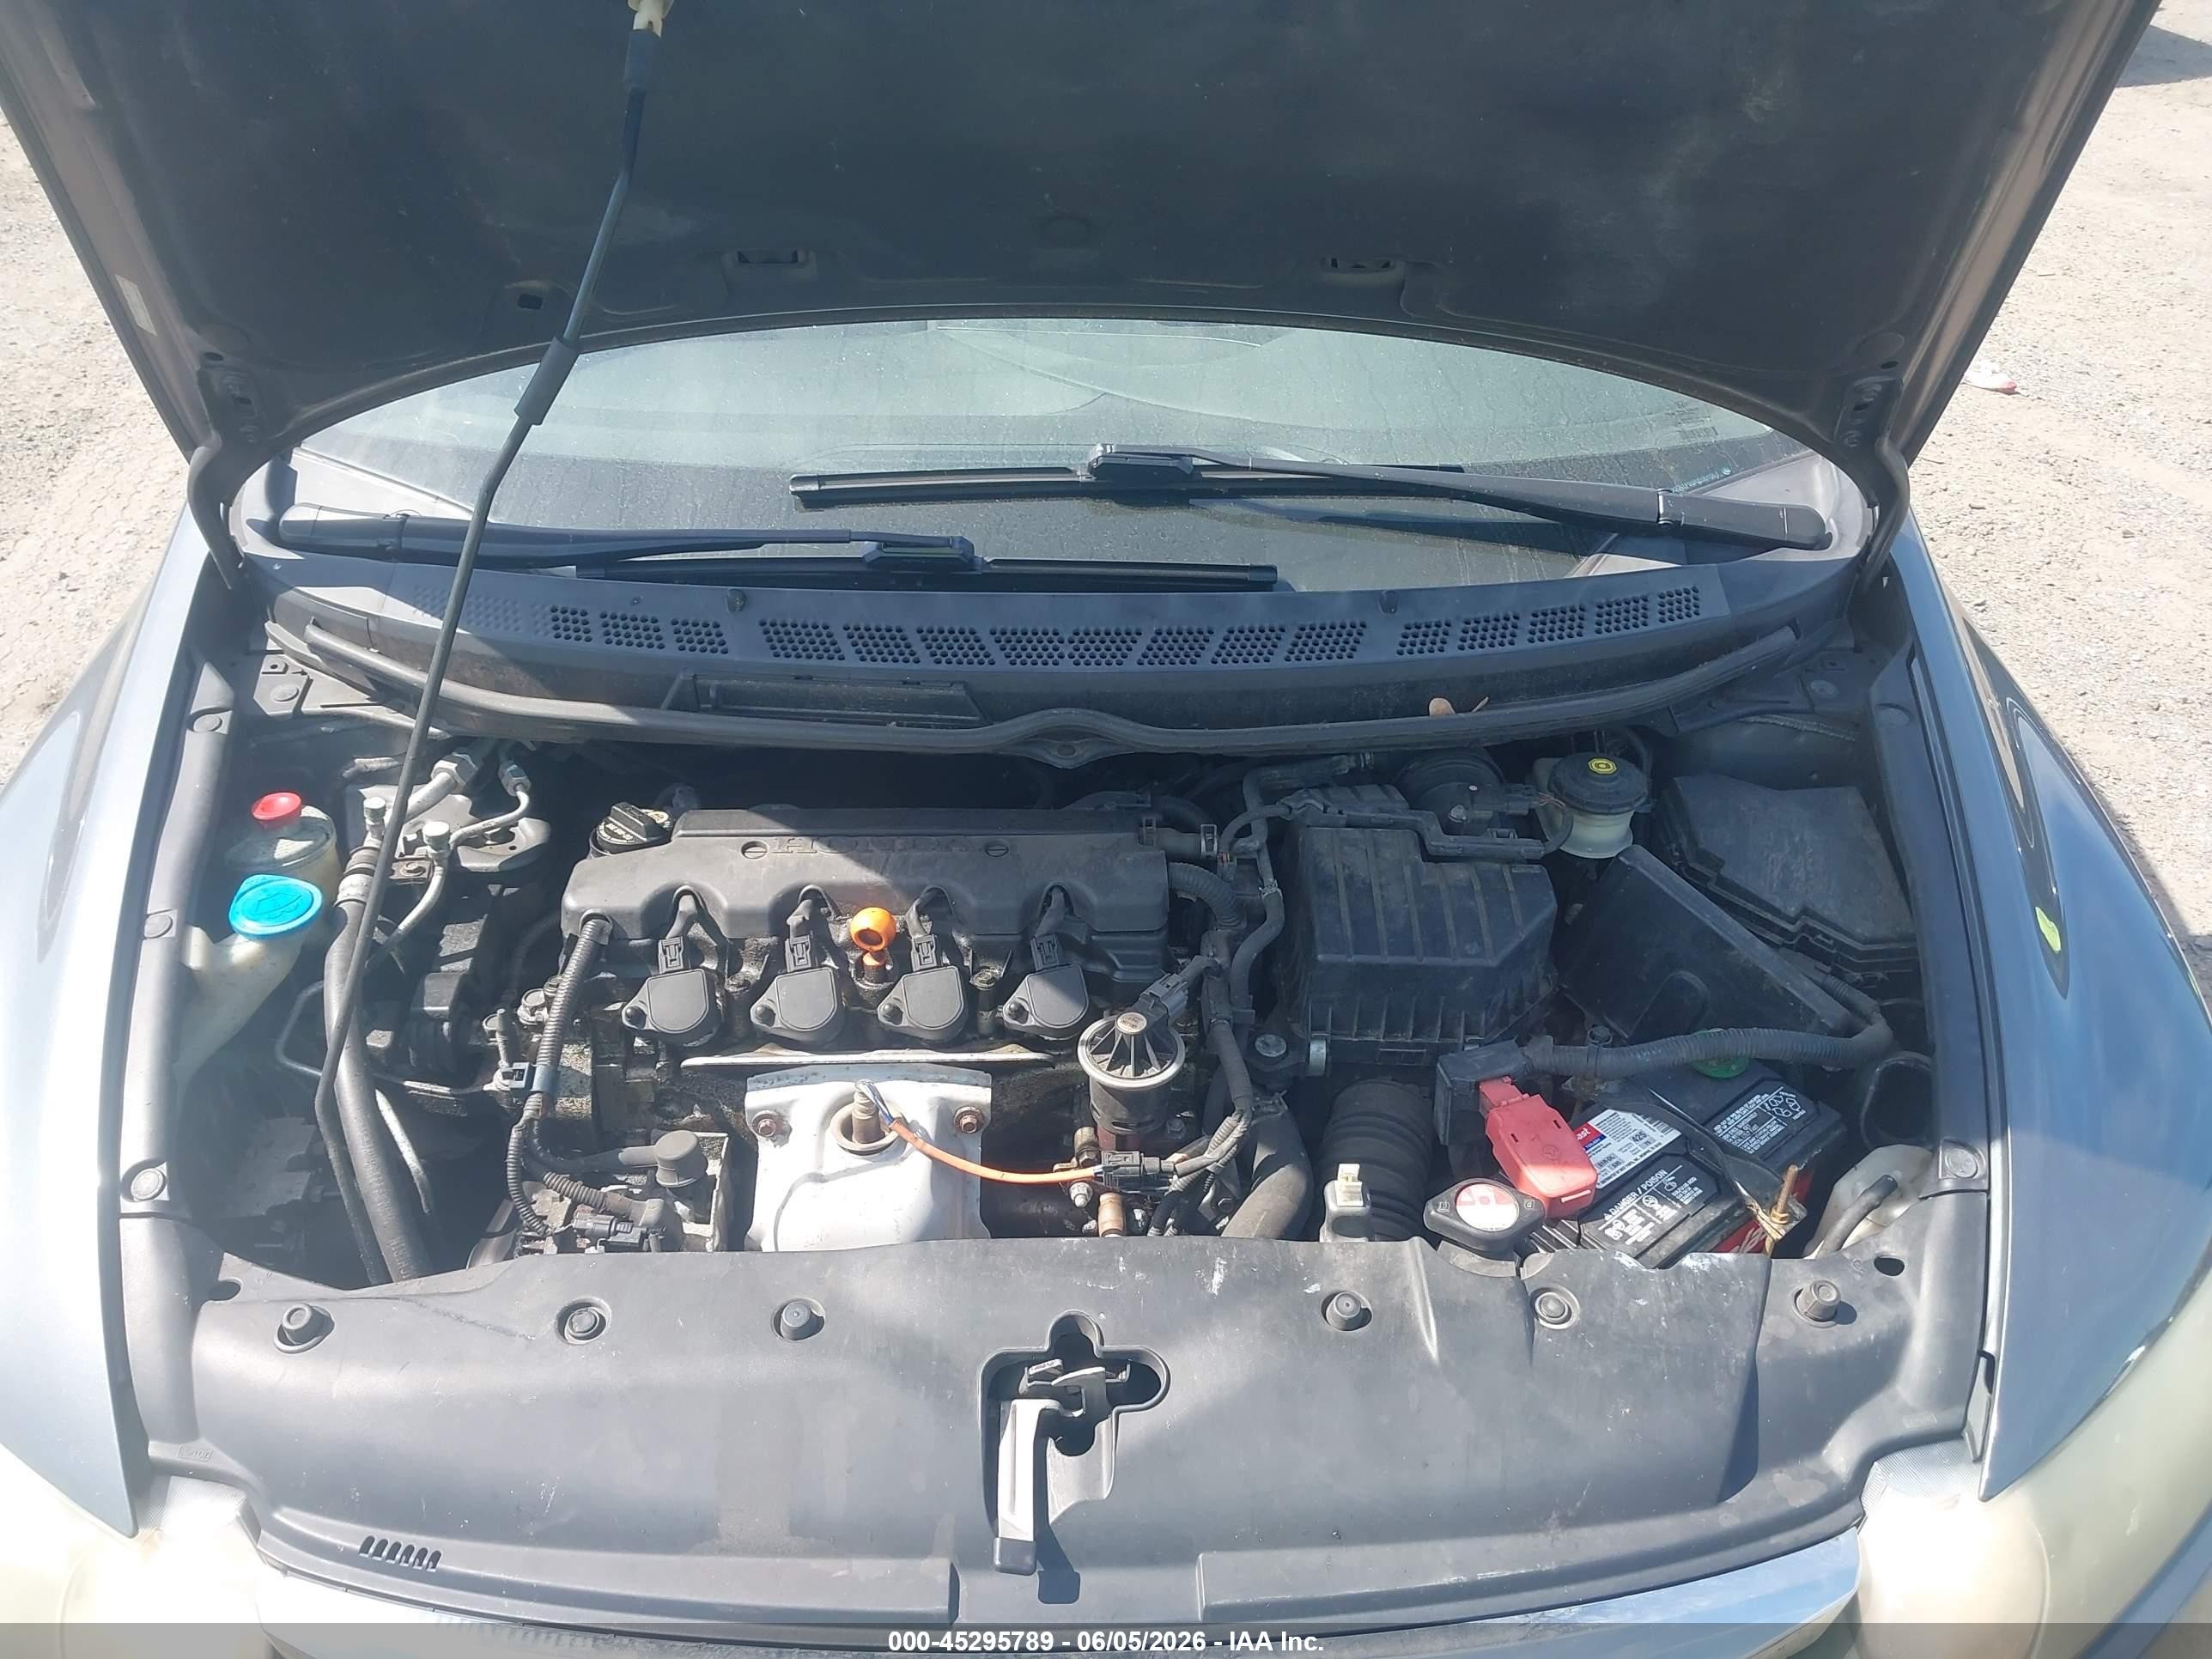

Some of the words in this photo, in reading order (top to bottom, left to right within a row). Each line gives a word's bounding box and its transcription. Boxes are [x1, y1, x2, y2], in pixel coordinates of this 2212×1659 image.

[1576, 1127, 1591, 1140] ast
[1632, 1131, 1647, 1142] 425
[1608, 1192, 1638, 1215] DANGER
[1641, 1169, 1668, 1190] POISON
